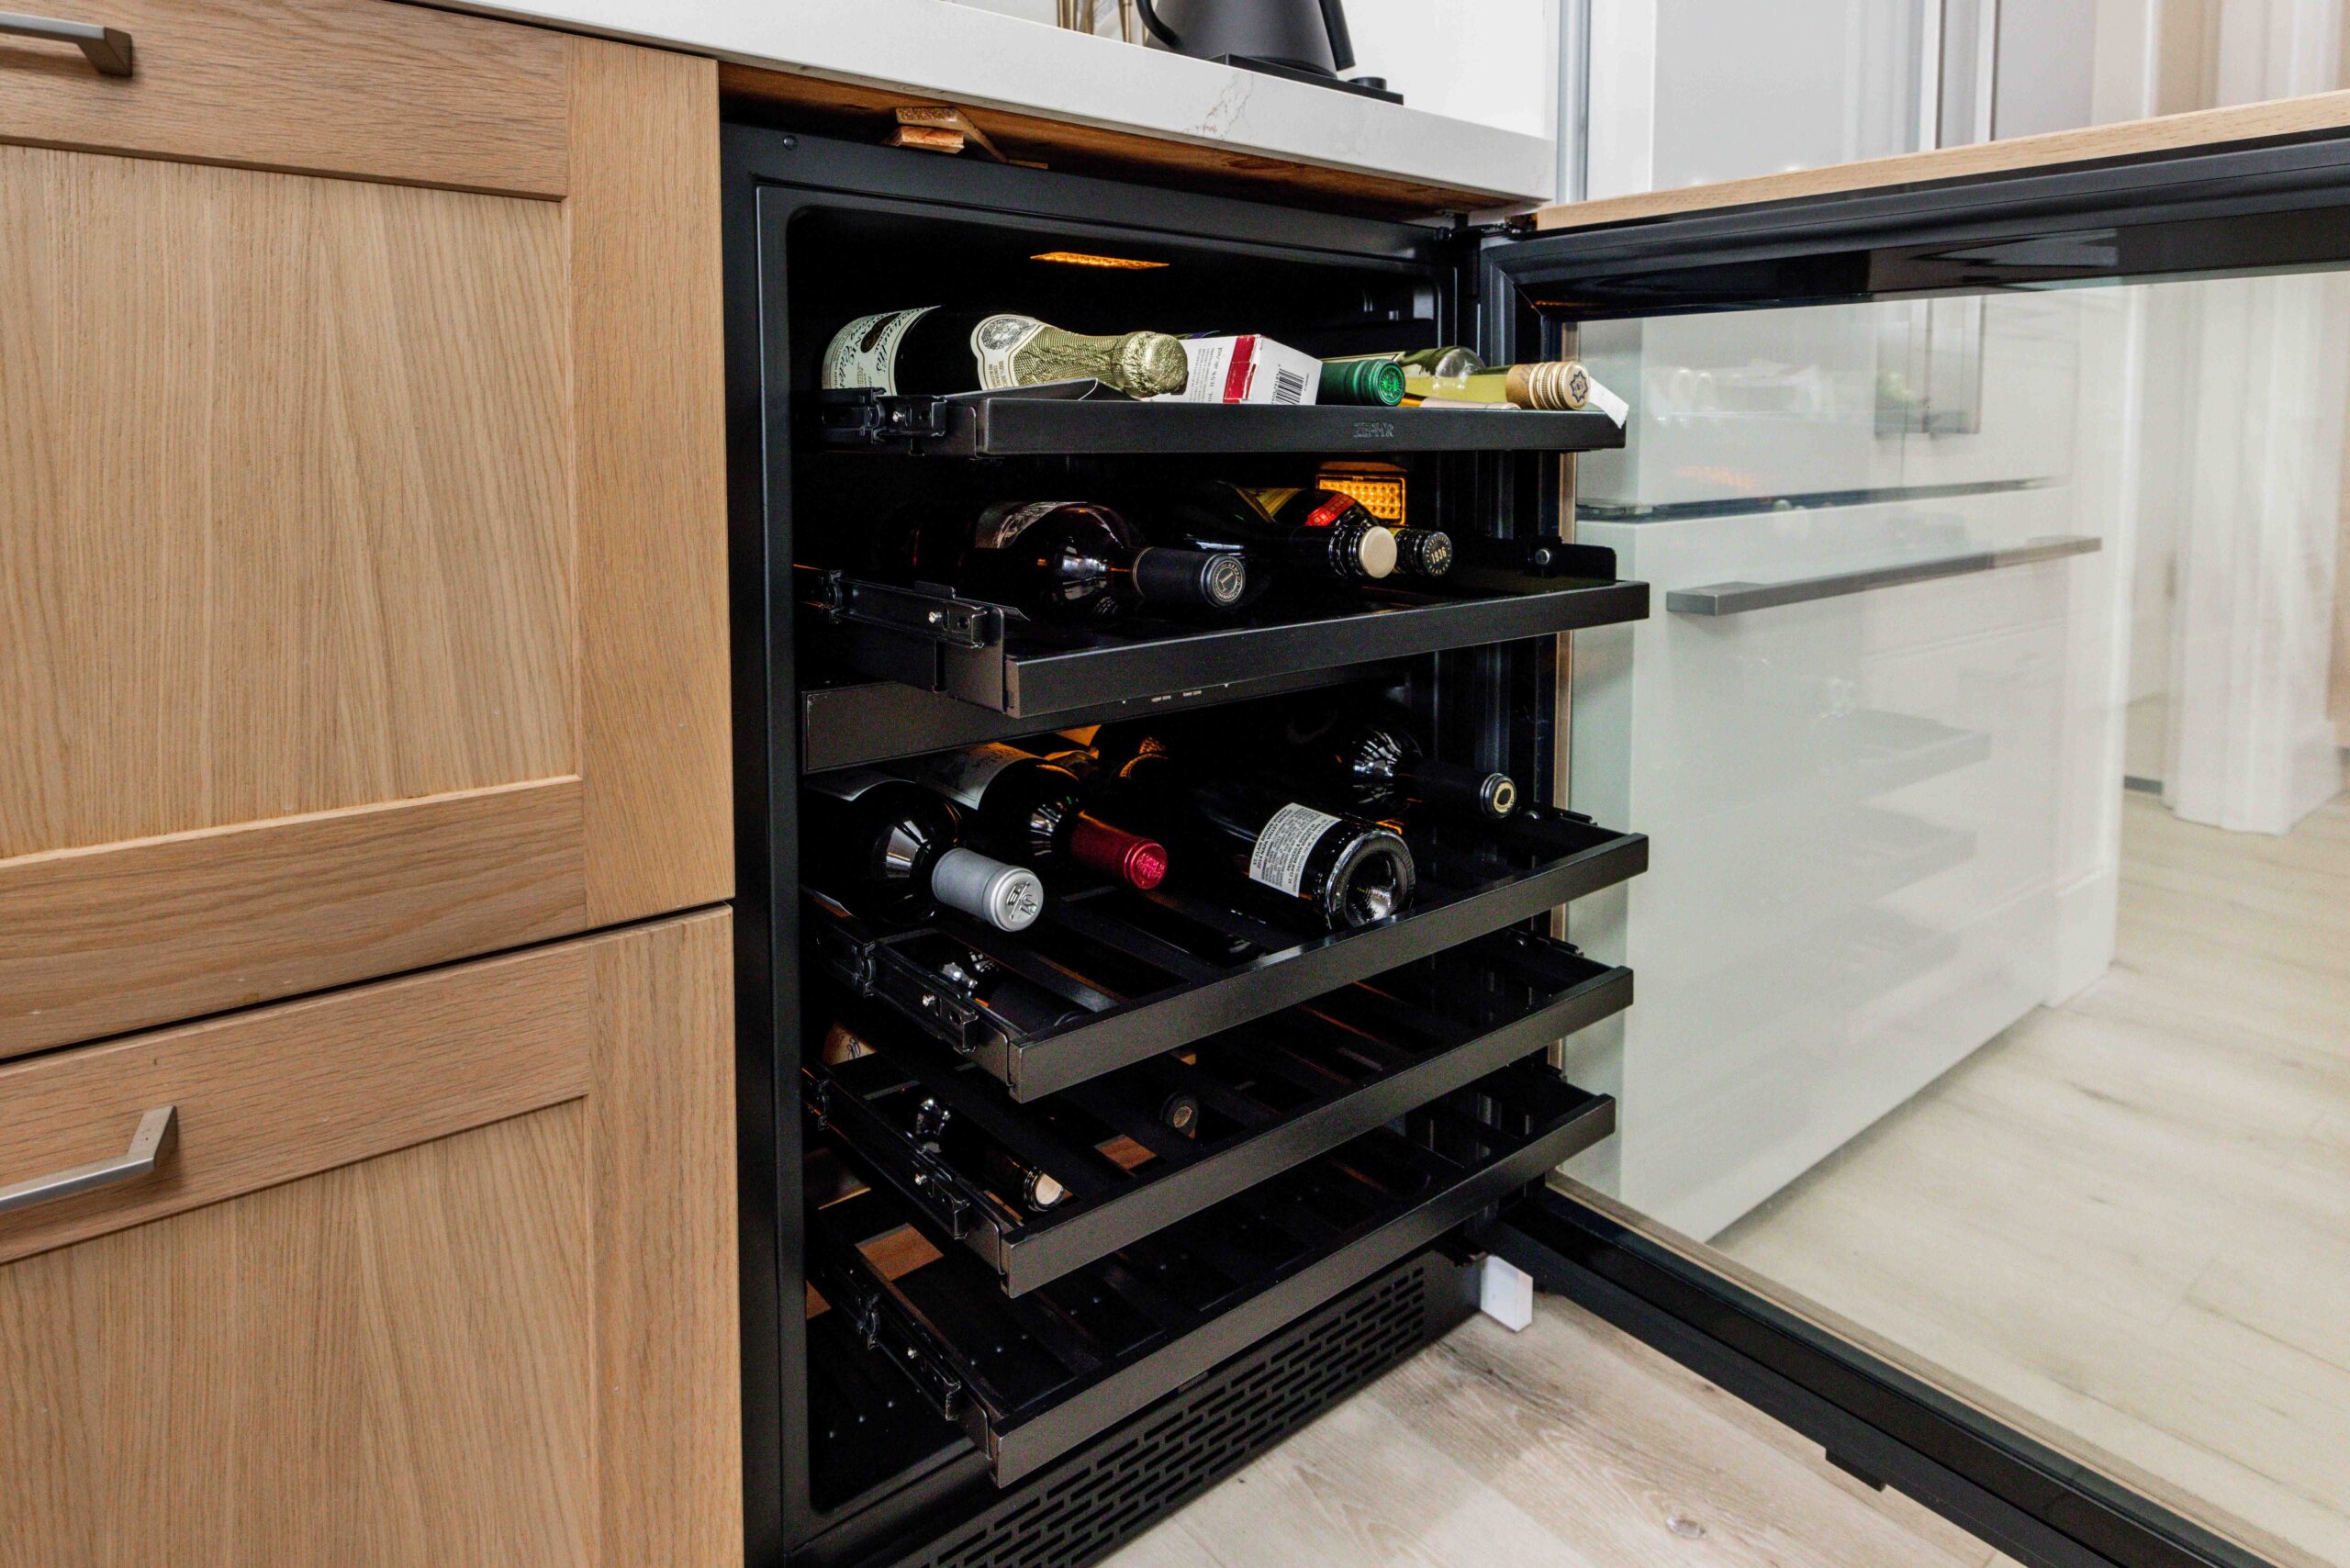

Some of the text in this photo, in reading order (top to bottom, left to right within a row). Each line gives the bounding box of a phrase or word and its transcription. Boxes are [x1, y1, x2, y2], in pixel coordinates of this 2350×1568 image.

[1431, 546, 1447, 564] 1936
[1261, 823, 1273, 841] BROWN
[1267, 823, 1278, 840] VALLEY
[1293, 846, 1304, 863] BROWN
